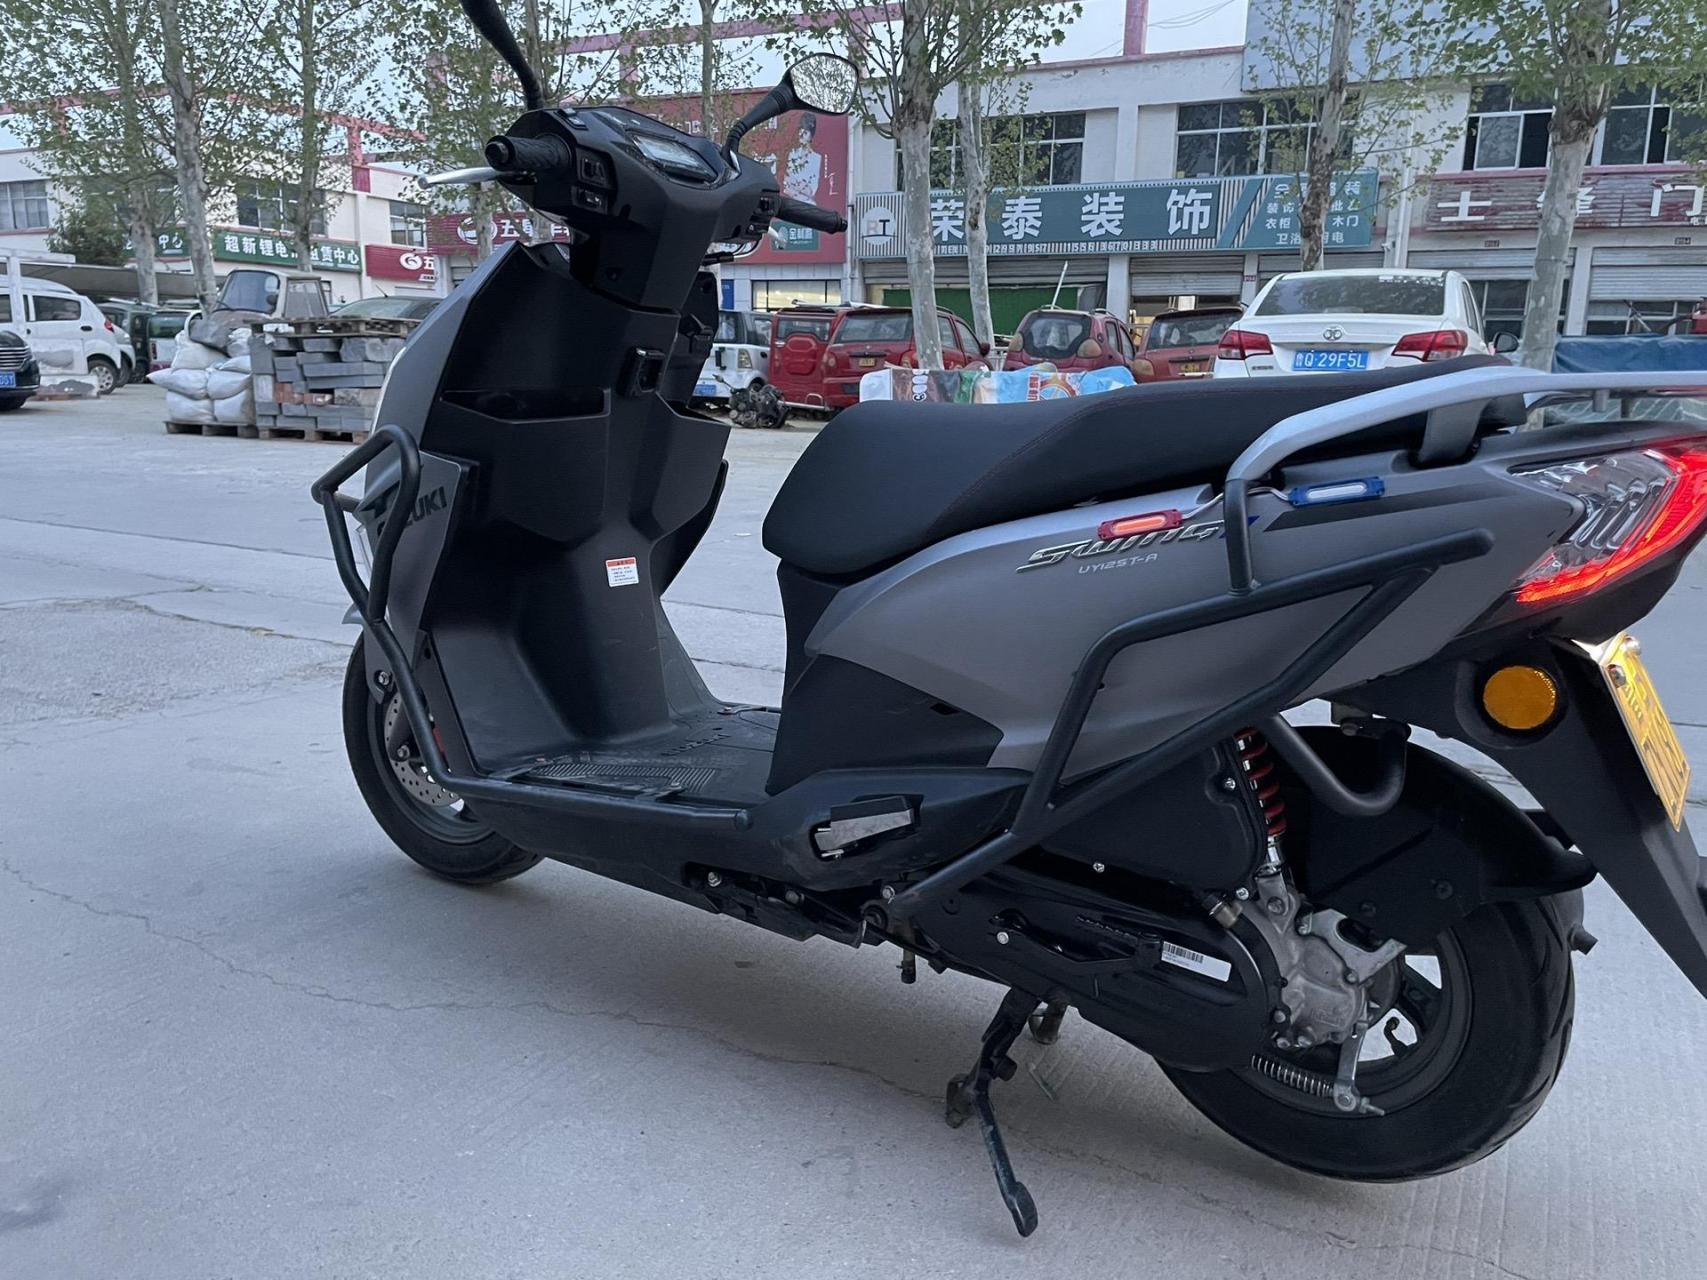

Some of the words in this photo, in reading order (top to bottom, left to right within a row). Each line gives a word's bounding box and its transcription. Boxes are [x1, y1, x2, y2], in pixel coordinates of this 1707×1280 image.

[930, 188, 1213, 242] 荣泰装饰
[1078, 553, 1159, 574] UY125T-A
